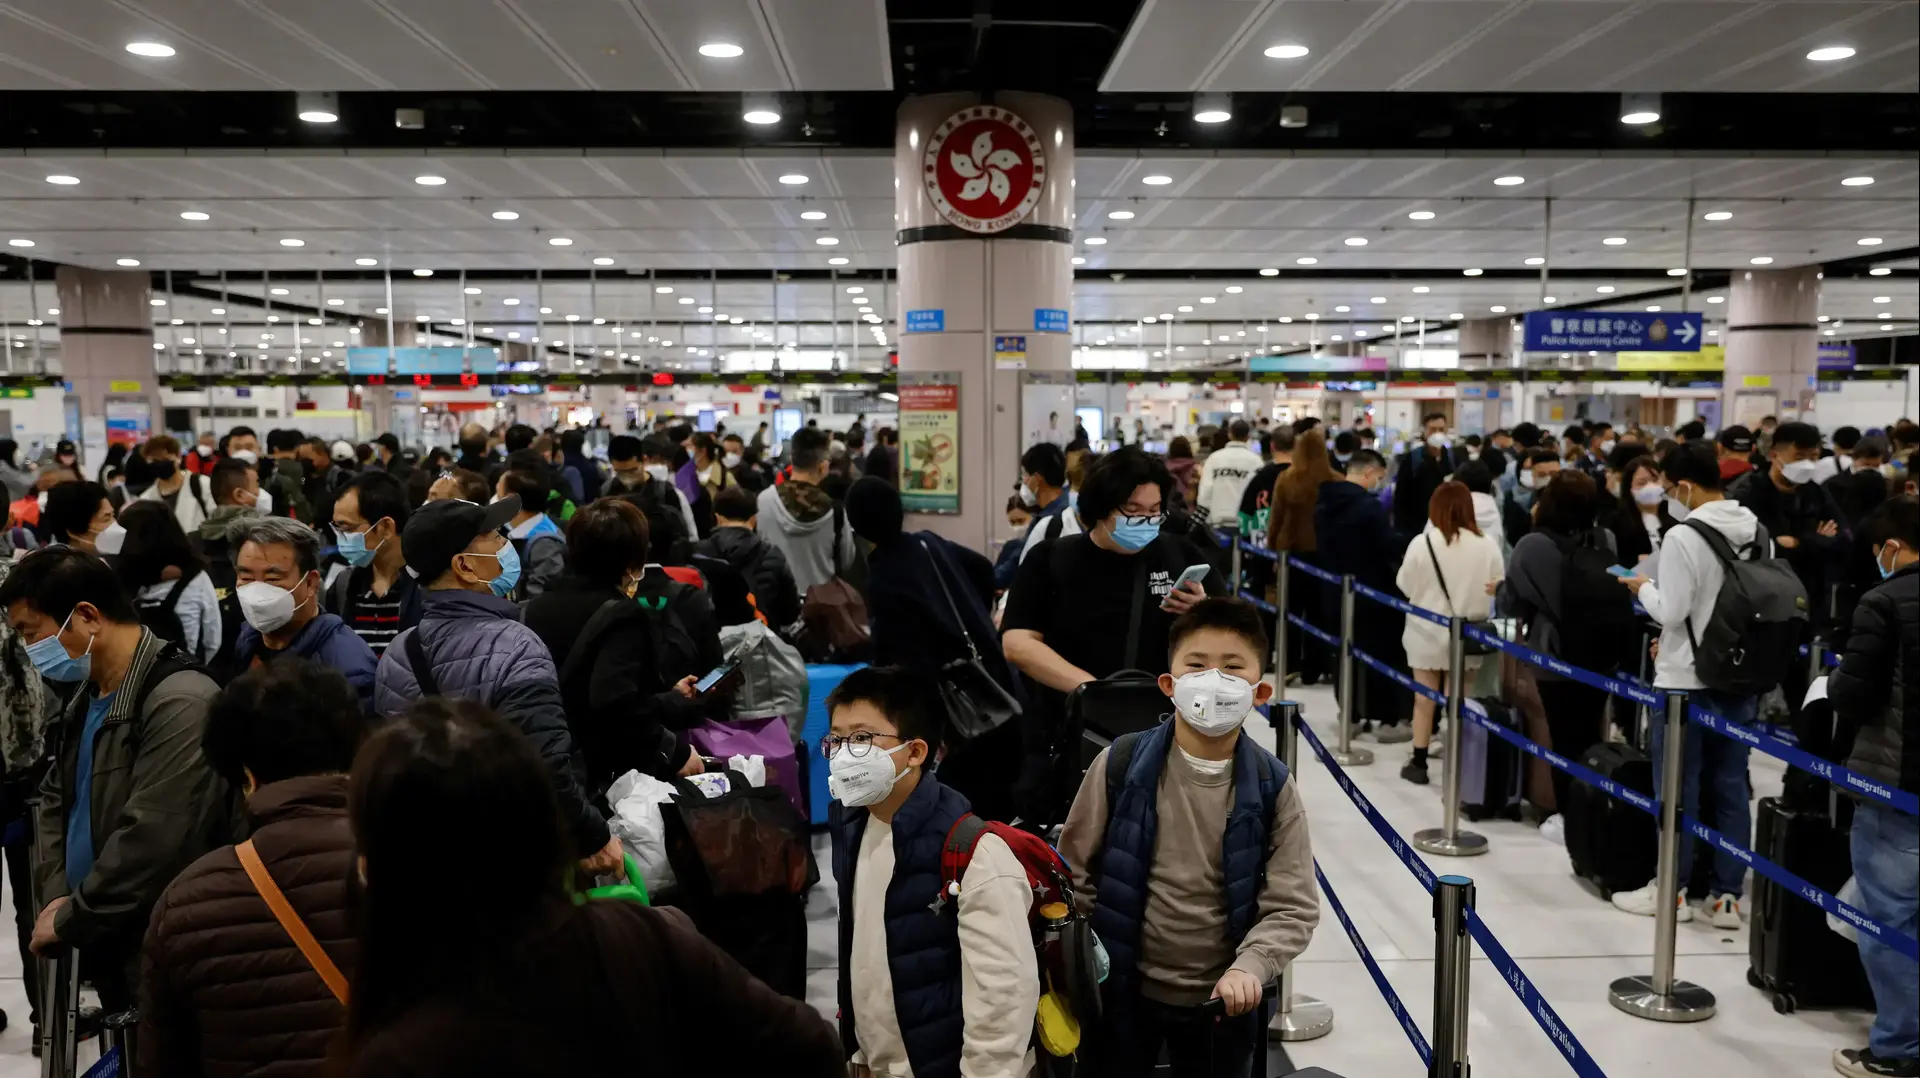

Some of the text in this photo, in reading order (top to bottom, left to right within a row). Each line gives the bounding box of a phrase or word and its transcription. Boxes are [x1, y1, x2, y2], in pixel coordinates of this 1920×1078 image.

[987, 210, 1021, 230] KONG
[1551, 318, 1644, 334] 警察報案中心
[1541, 335, 1641, 347] Police Reporting Centre
[1628, 687, 1656, 704] Immigration
[1726, 722, 1760, 745] Immigration
[1847, 773, 1891, 799] Immigration
[1622, 789, 1650, 808] Immigration
[1720, 837, 1752, 863] Immigration
[1410, 853, 1432, 887] Immigration
[1838, 904, 1880, 935] Immigration
[1507, 965, 1575, 1058] 入境處 Immigration
[1405, 1016, 1428, 1058] Immigration
